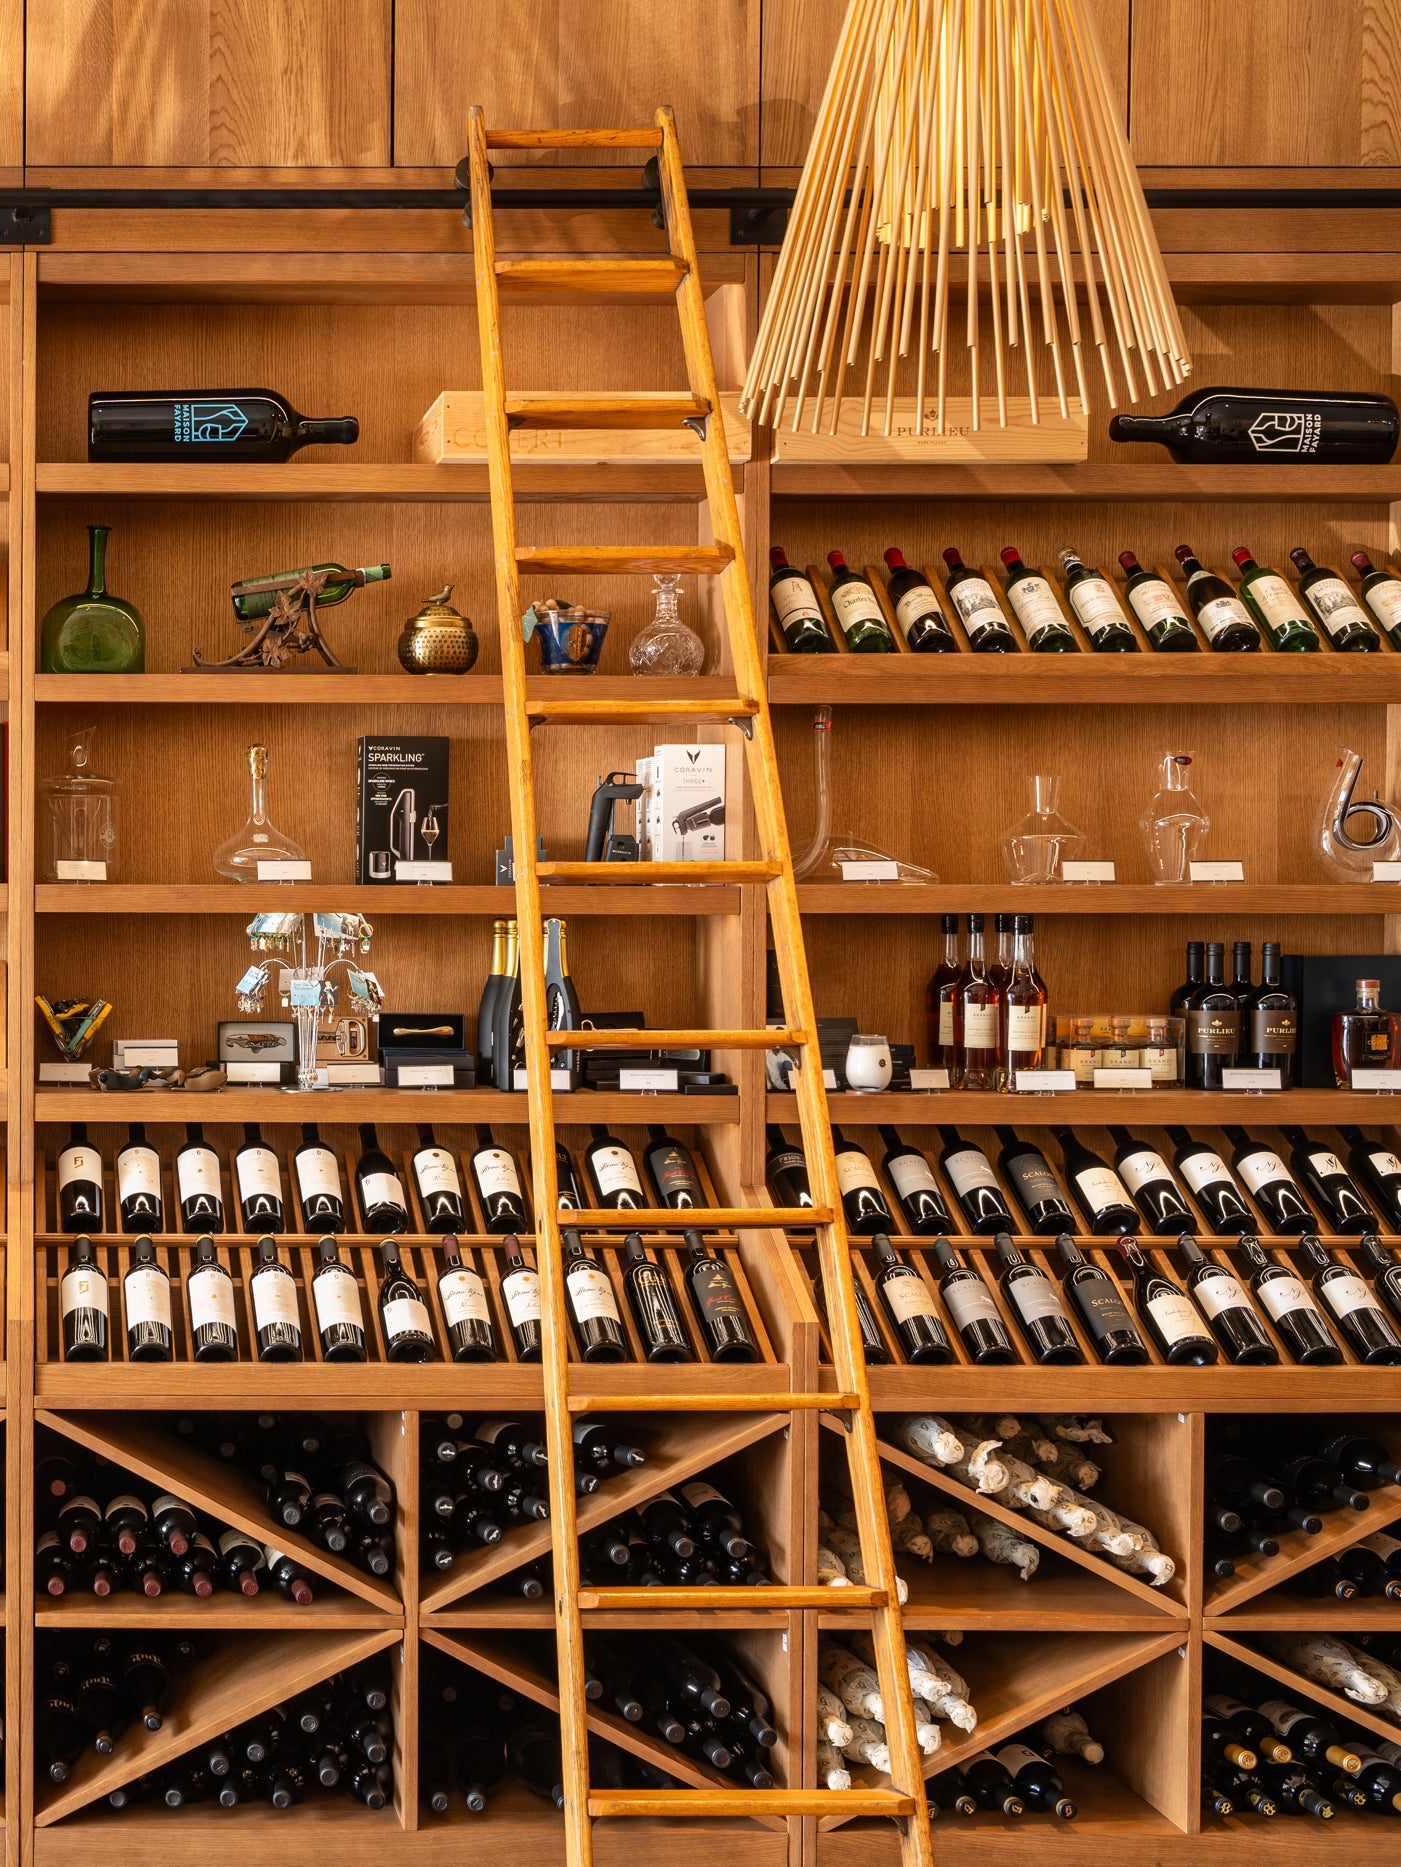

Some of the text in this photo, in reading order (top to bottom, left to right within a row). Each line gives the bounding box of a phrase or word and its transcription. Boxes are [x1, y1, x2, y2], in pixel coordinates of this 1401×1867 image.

[182, 404, 190, 442] MAISON
[1302, 413, 1314, 453] MAISON
[1309, 414, 1321, 453] FAYARD
